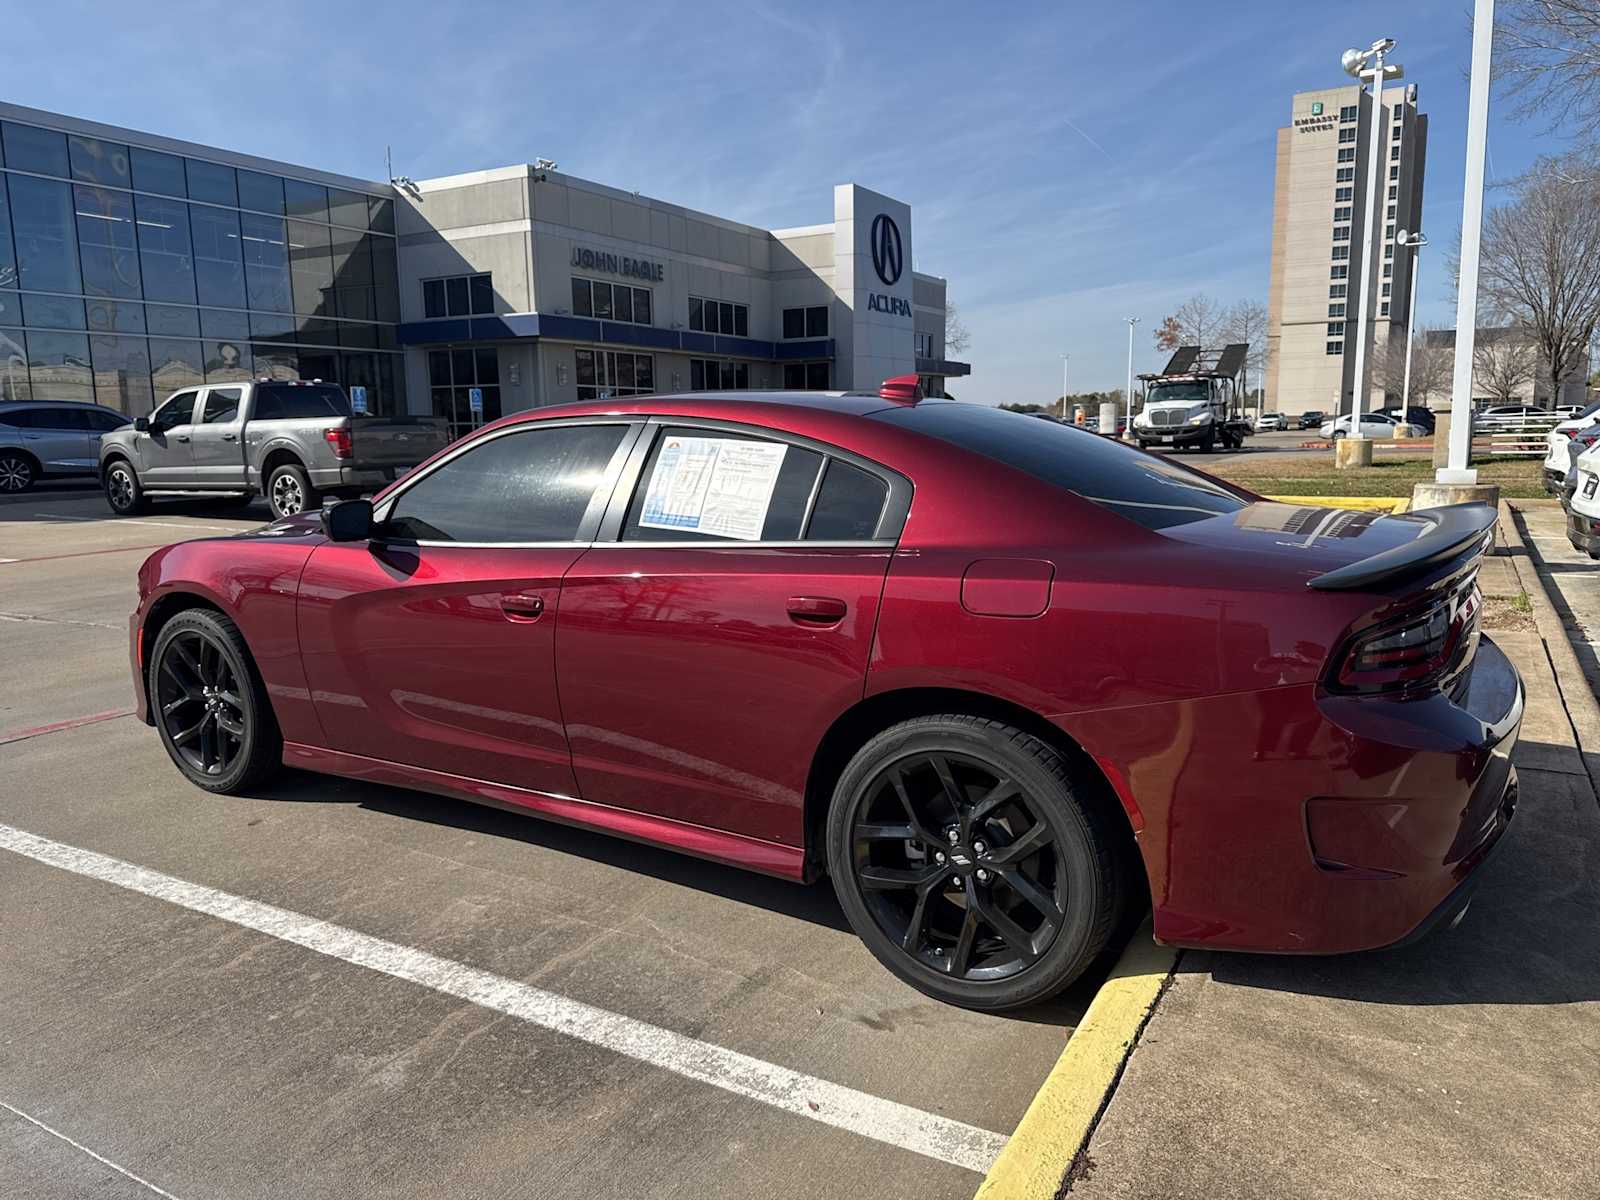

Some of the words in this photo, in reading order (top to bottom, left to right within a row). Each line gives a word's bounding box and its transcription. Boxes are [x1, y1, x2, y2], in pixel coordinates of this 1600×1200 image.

[1295, 115, 1339, 126] EMBASSY
[1300, 124, 1333, 133] SUITES
[571, 247, 618, 273] JOHN
[623, 257, 664, 282] EAGLE
[868, 293, 912, 317] ACURA
